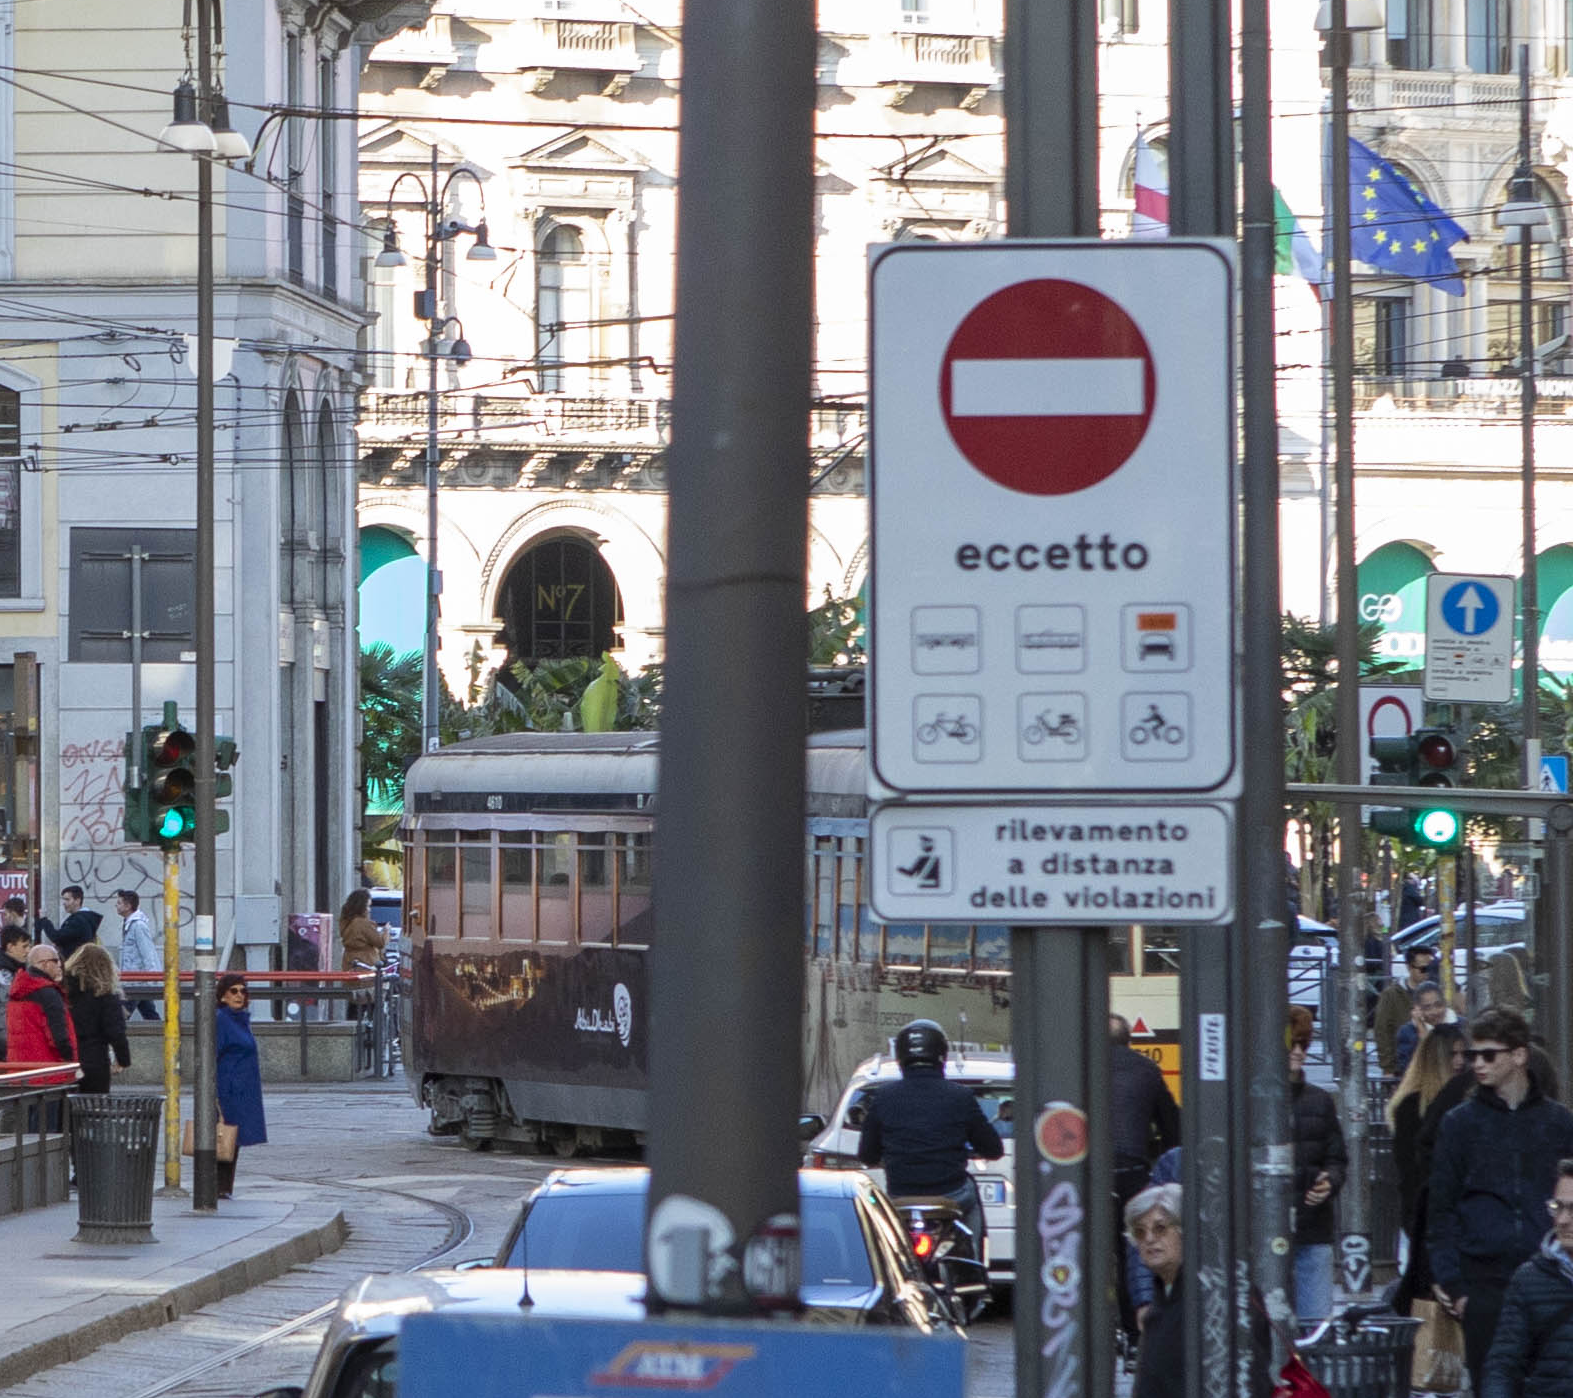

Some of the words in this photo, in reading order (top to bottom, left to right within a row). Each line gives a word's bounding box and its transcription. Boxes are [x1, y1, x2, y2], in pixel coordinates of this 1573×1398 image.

[956, 534, 1149, 572] eccetto
[995, 819, 1189, 842] rilevamento
[1008, 857, 1025, 876] a
[1040, 853, 1176, 877] distanza
[969, 887, 1050, 910] delle
[1063, 885, 1217, 910] violazioni
